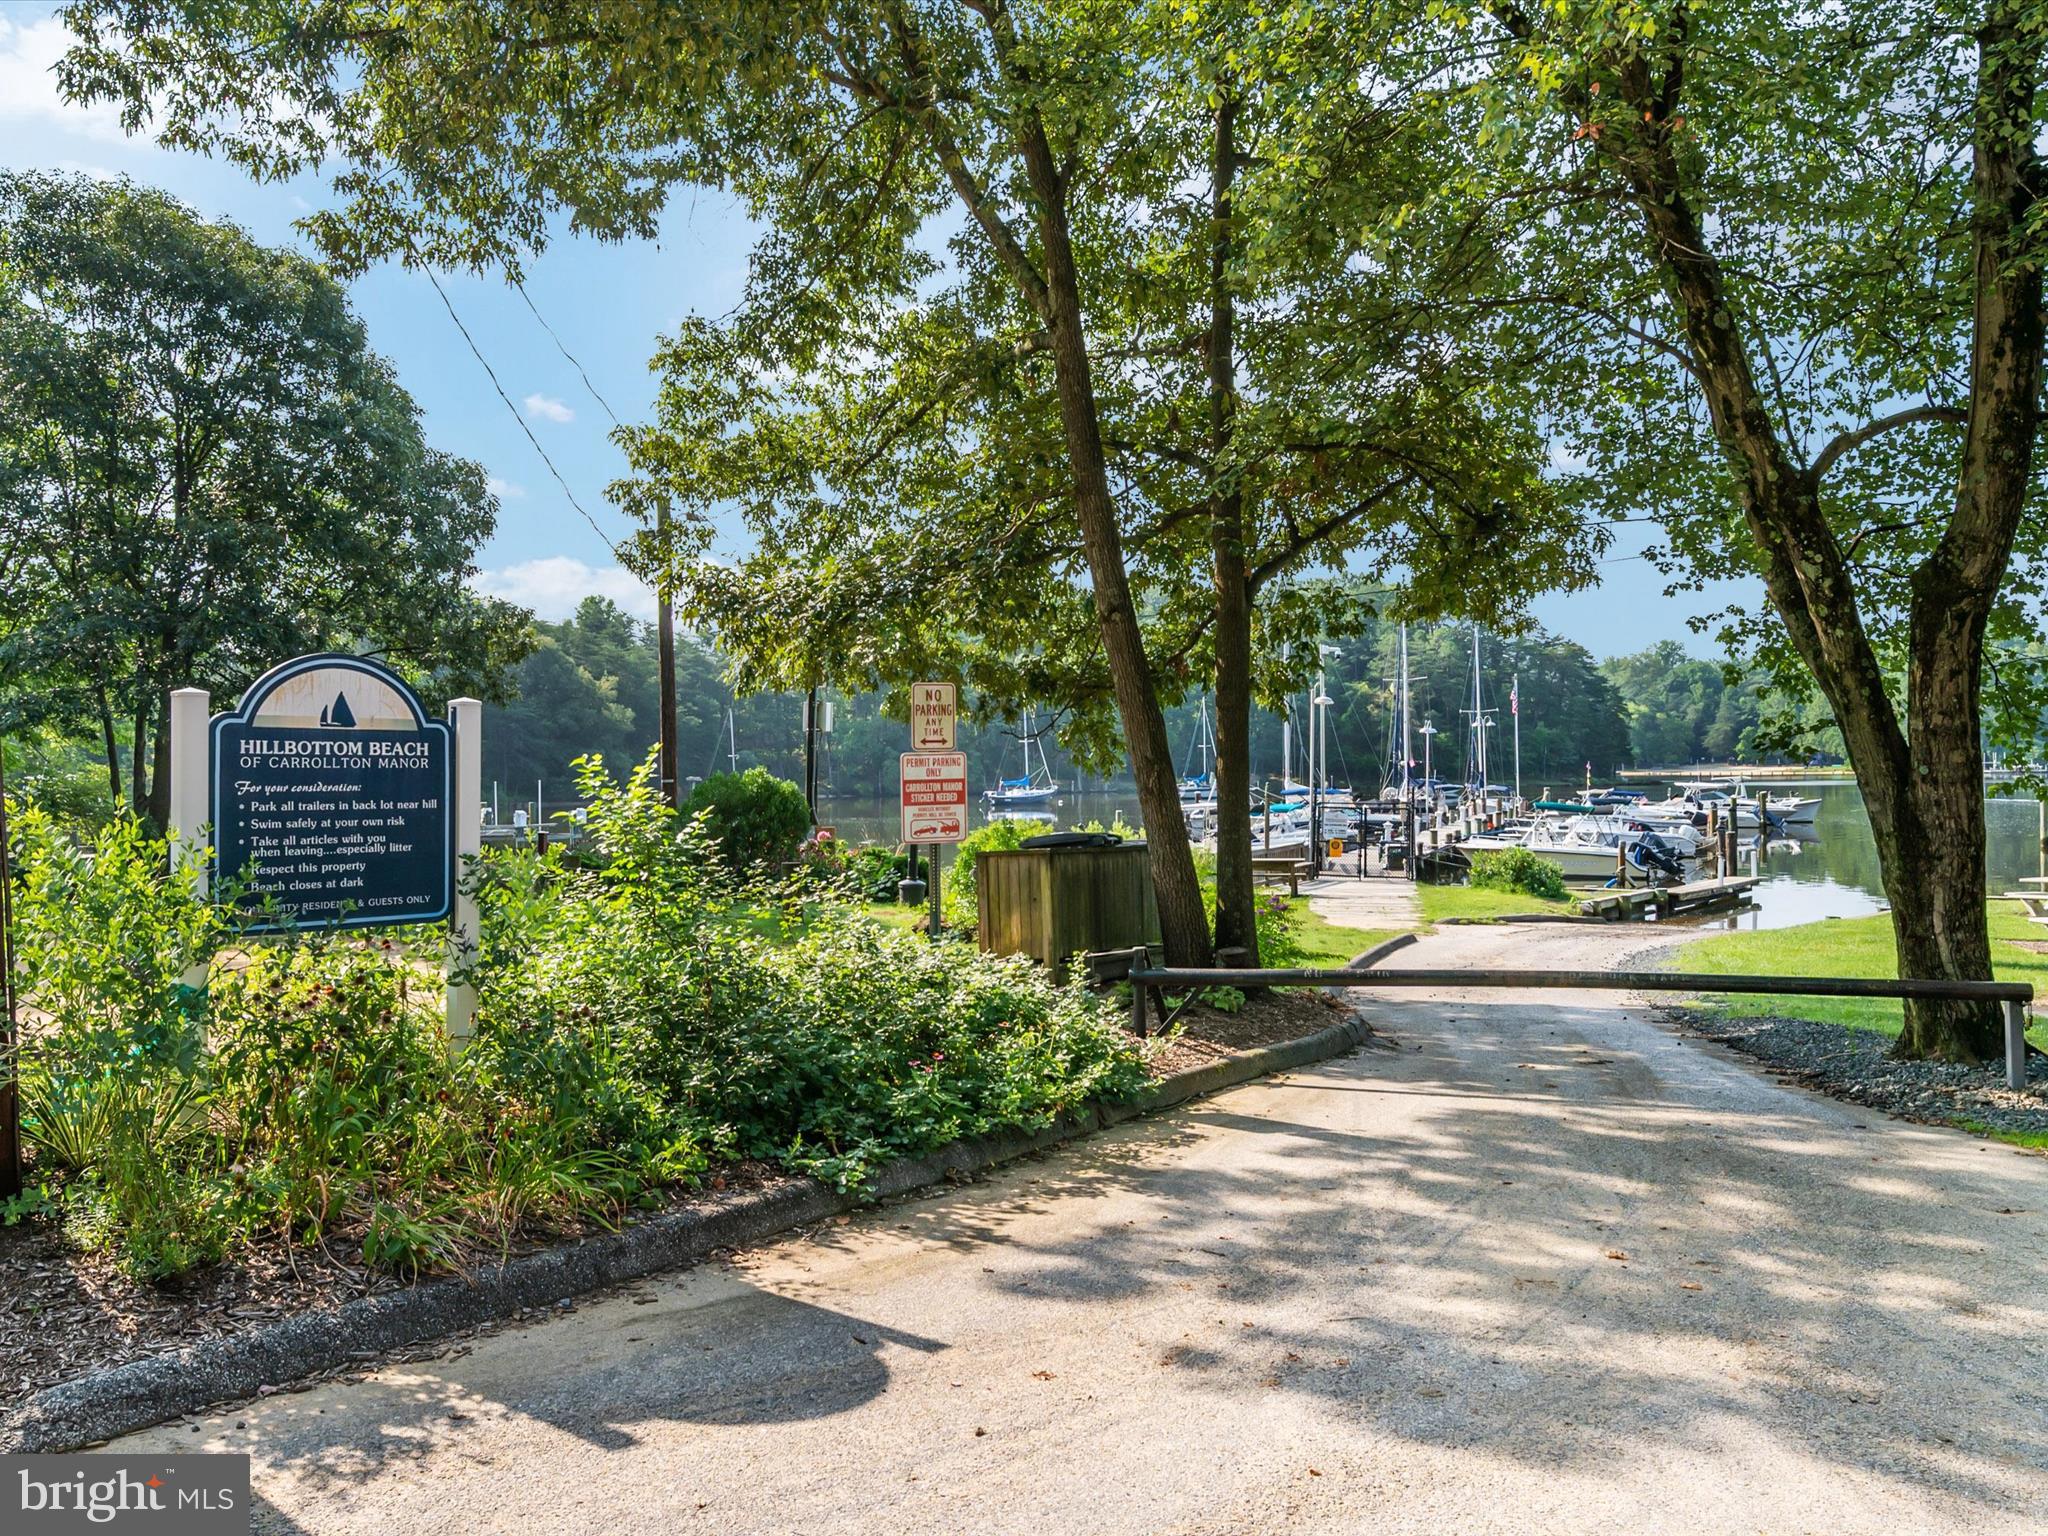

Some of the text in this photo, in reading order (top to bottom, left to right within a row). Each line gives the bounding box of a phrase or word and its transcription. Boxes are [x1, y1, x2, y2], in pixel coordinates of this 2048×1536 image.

[925, 689, 942, 701] NO
[915, 703, 952, 716] PARKING
[926, 717, 942, 726] ANY
[924, 727, 944, 736] TIME
[240, 739, 429, 756] HILLBOTTOM BEACH
[240, 757, 429, 769] OF CARROLLTON MANOR
[906, 757, 961, 768] PERMIT PARKING
[926, 767, 942, 777] ONLY
[235, 780, 362, 796] For your consideration:
[251, 802, 277, 812] Park
[281, 801, 294, 811] all
[298, 801, 335, 811] trailers
[339, 801, 349, 810] in
[352, 800, 377, 810] back
[380, 800, 394, 809] lot
[422, 799, 437, 809] hill
[251, 816, 405, 830] Swim safely at your own risk
[251, 834, 386, 847] Take all articles with you
[251, 846, 280, 857] when
[390, 842, 413, 853] litter
[251, 862, 366, 876] Respect this property
[251, 877, 364, 892] Beach closes at dark
[302, 899, 352, 911] RESIDEN
[358, 899, 365, 907] &
[368, 897, 403, 906] GUESTS
[406, 895, 431, 904] ONLY
